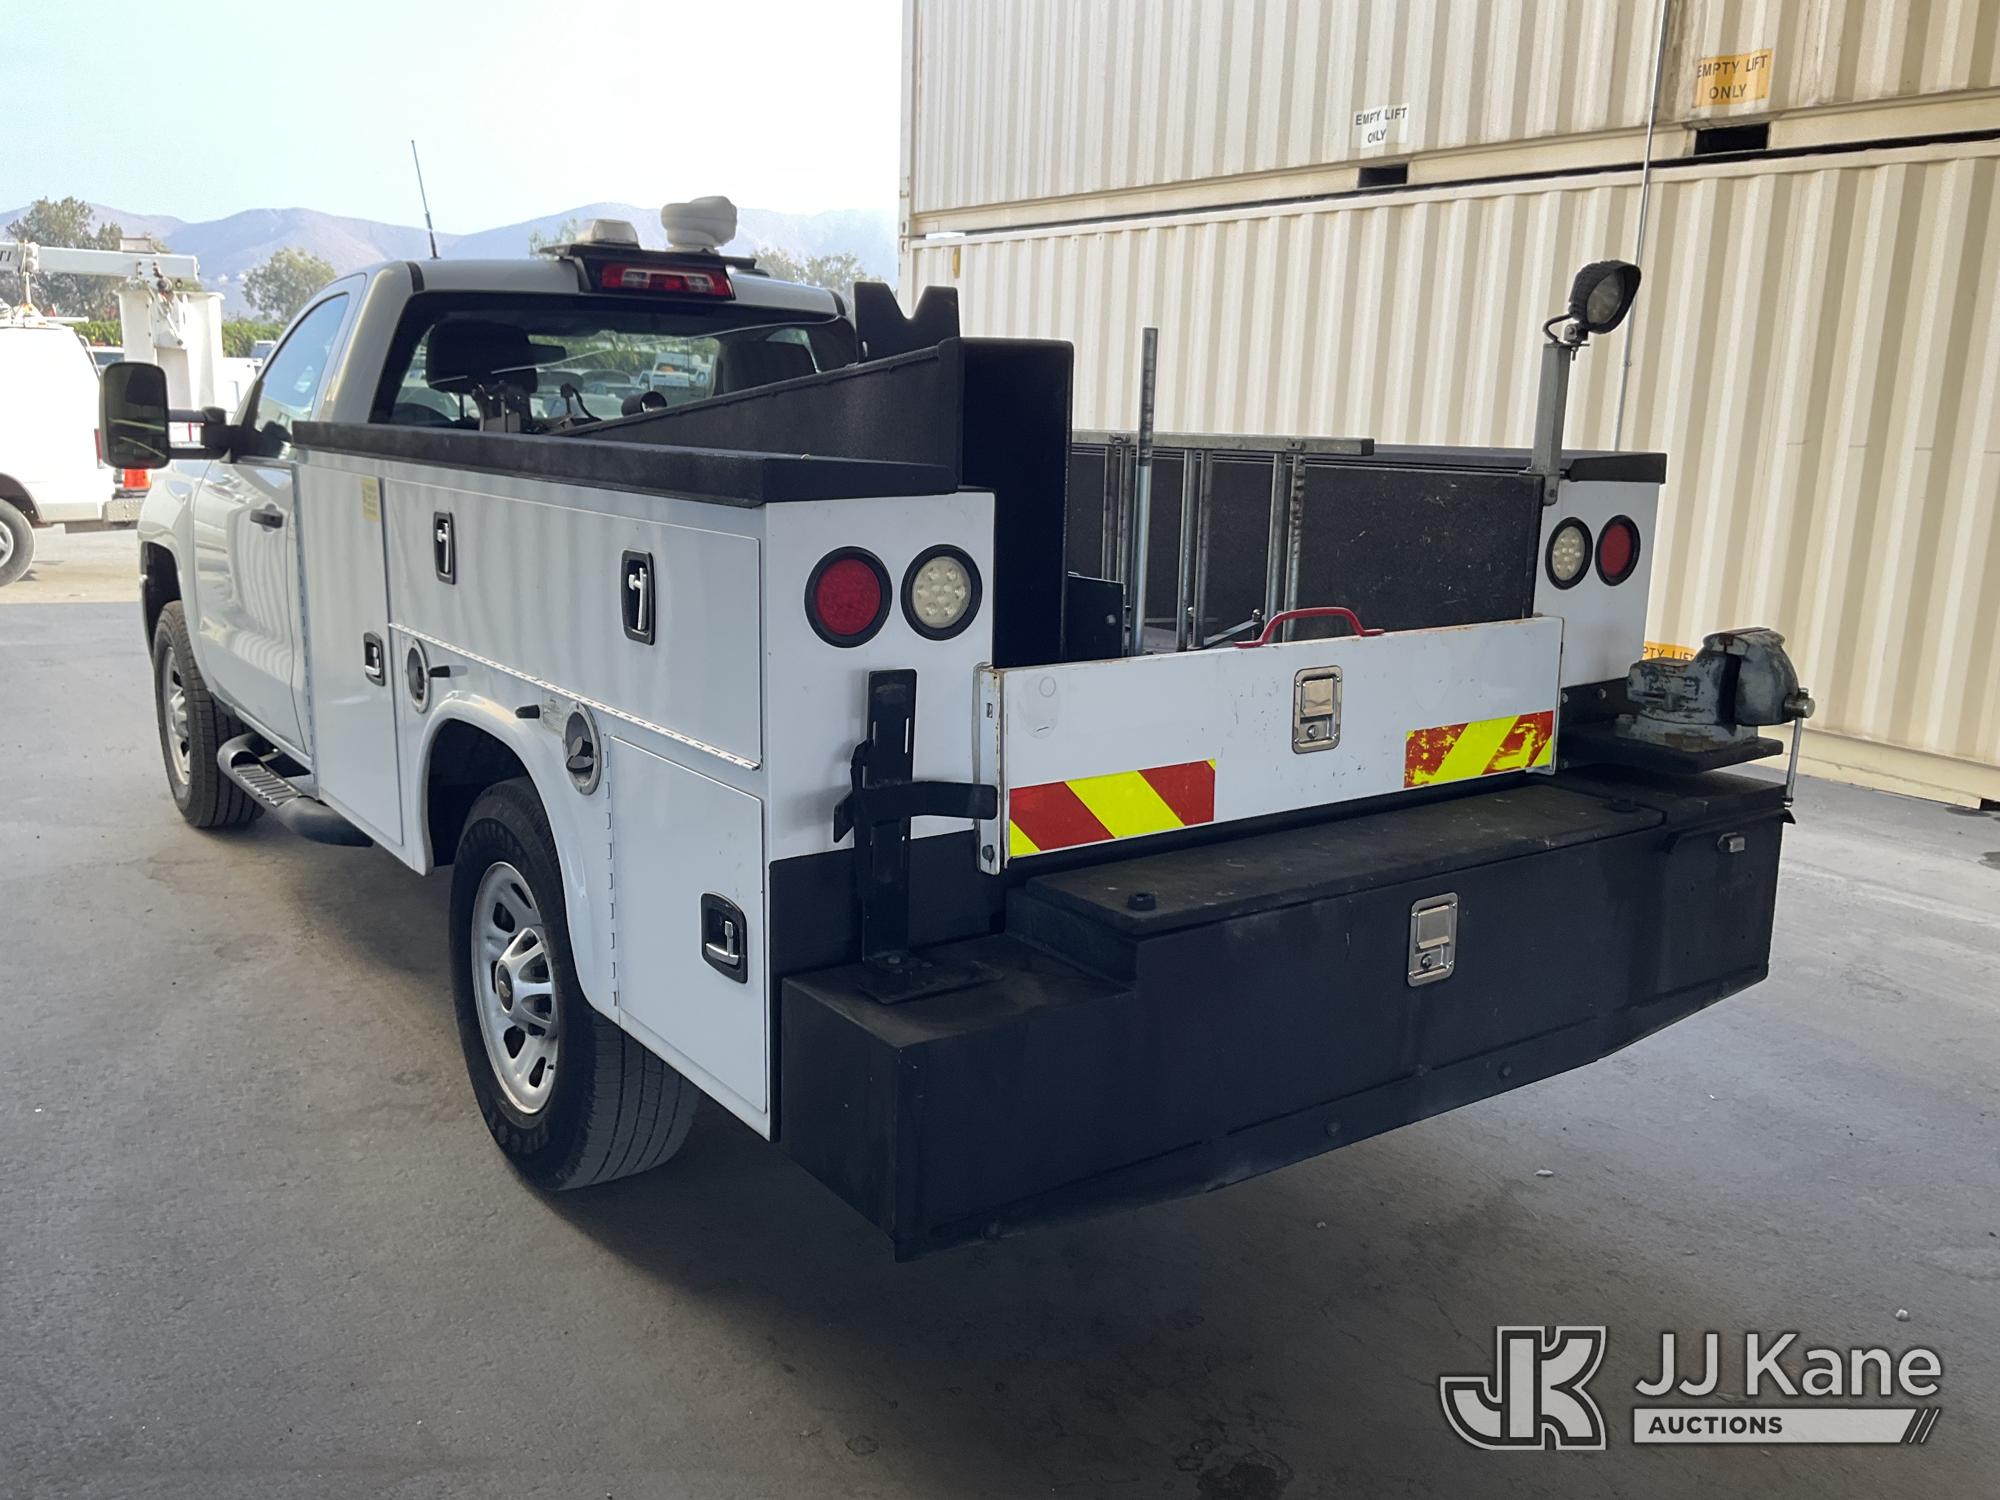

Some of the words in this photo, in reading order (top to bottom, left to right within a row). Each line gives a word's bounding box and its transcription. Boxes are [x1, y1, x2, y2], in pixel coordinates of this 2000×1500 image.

[1697, 61, 1739, 78] EMPTY
[1745, 54, 1768, 73] LIFT
[1709, 83, 1747, 100] ONLY
[1384, 107, 1407, 120] LIFT
